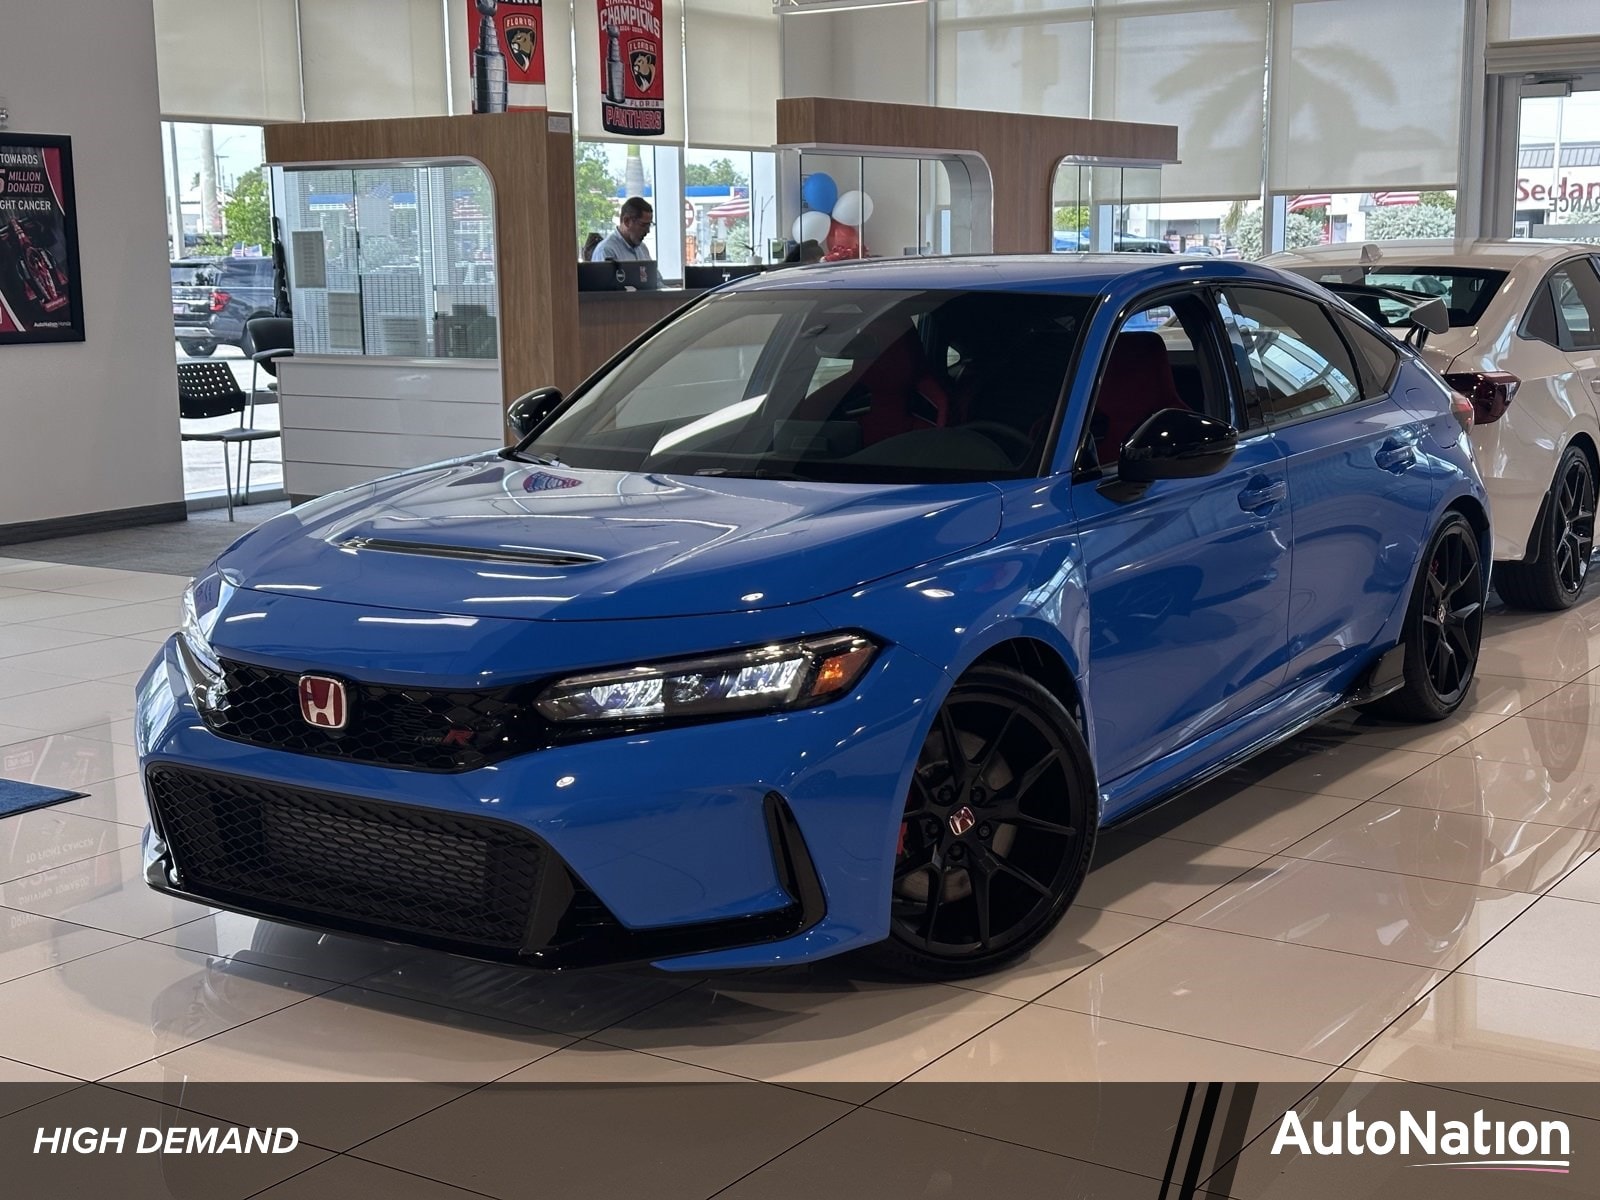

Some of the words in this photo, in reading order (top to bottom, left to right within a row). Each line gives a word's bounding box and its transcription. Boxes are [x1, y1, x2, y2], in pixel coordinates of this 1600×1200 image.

[600, 5, 660, 38] CHAMPIONS
[606, 106, 662, 130] PANTHERS
[0, 153, 39, 165] TOWARDS
[8, 171, 41, 182] MILLION
[7, 183, 45, 193] DONATED
[18, 200, 52, 211] CANCER
